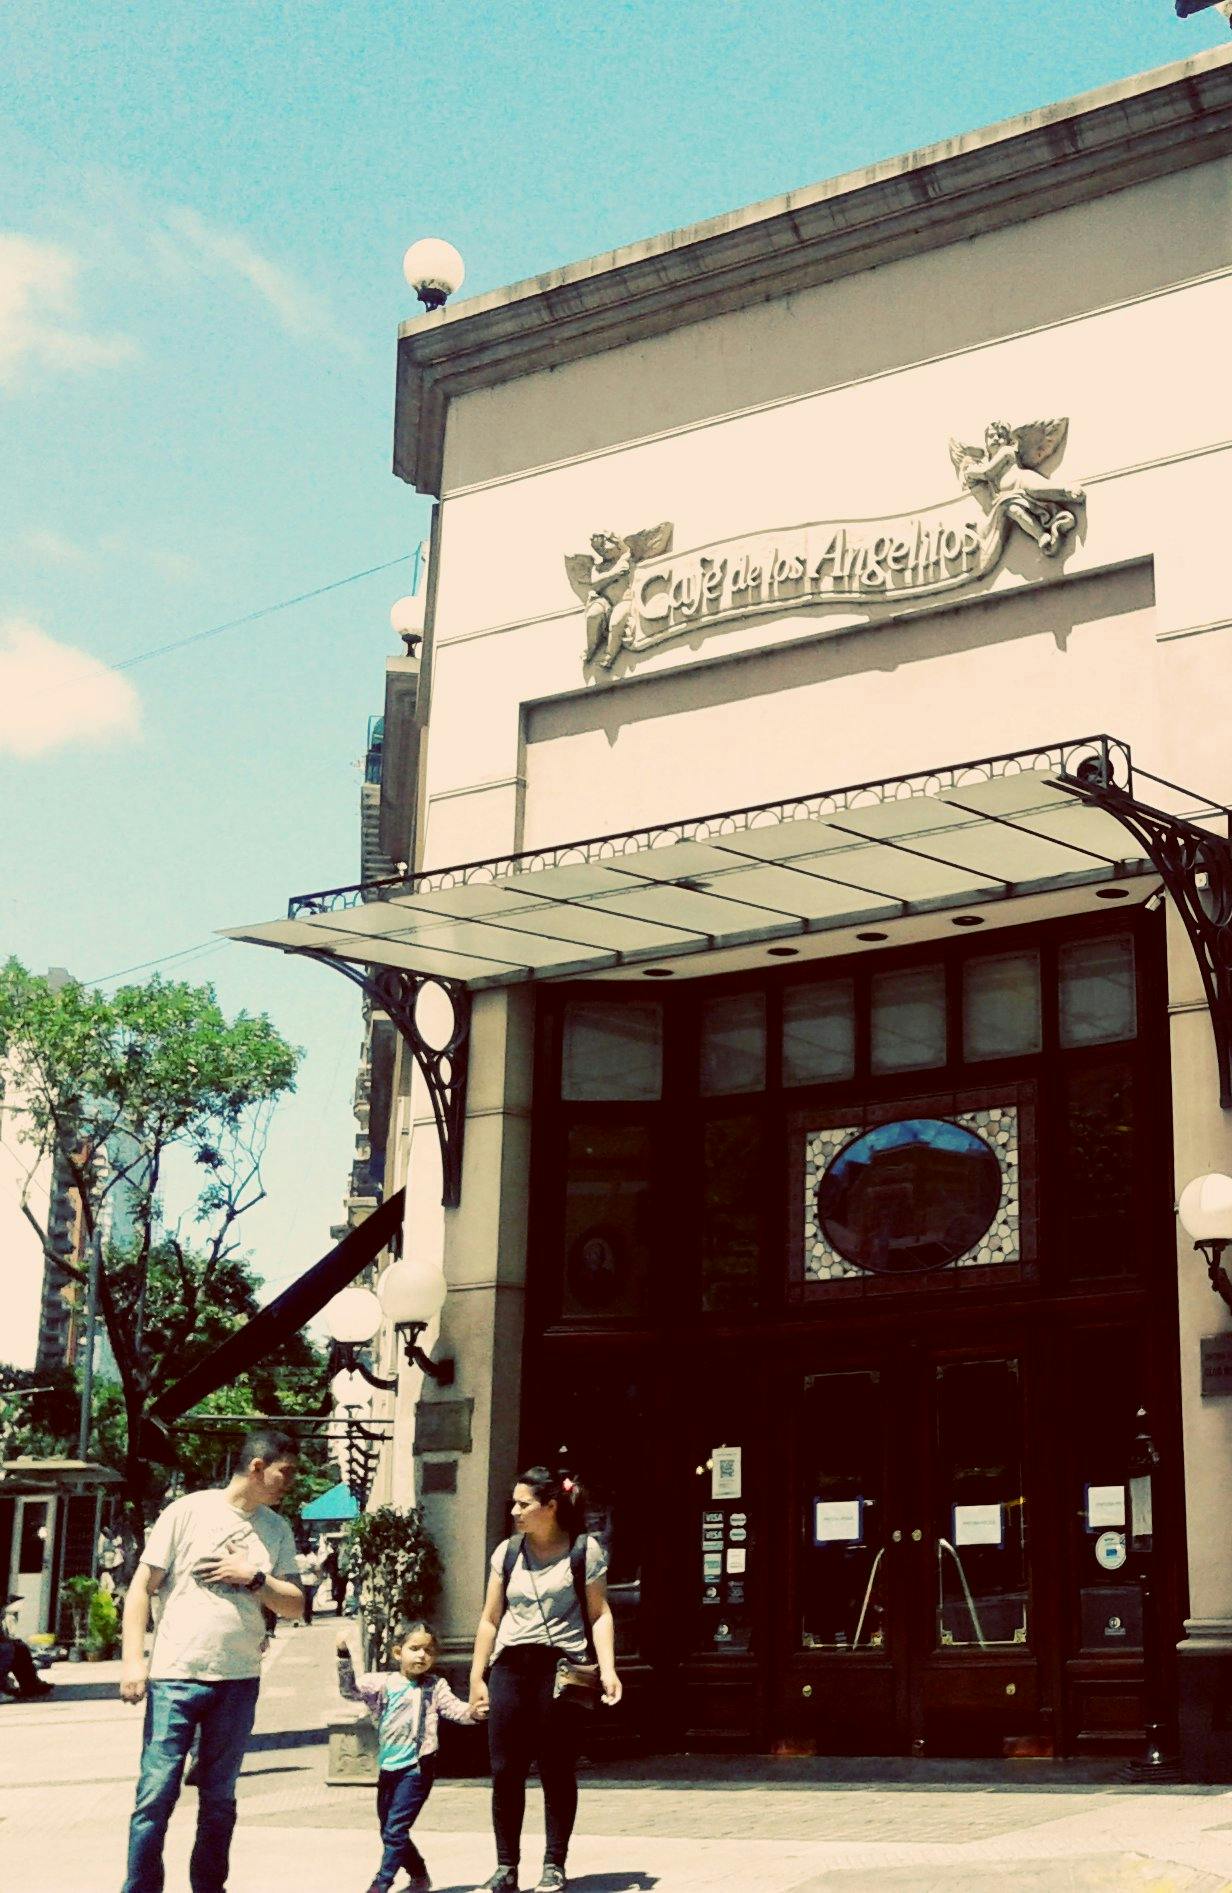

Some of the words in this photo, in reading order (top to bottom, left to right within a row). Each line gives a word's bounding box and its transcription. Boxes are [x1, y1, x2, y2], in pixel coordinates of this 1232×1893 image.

[637, 557, 728, 620] Café
[730, 554, 762, 592] de
[768, 548, 808, 583] los
[808, 520, 981, 586] Angelitos
